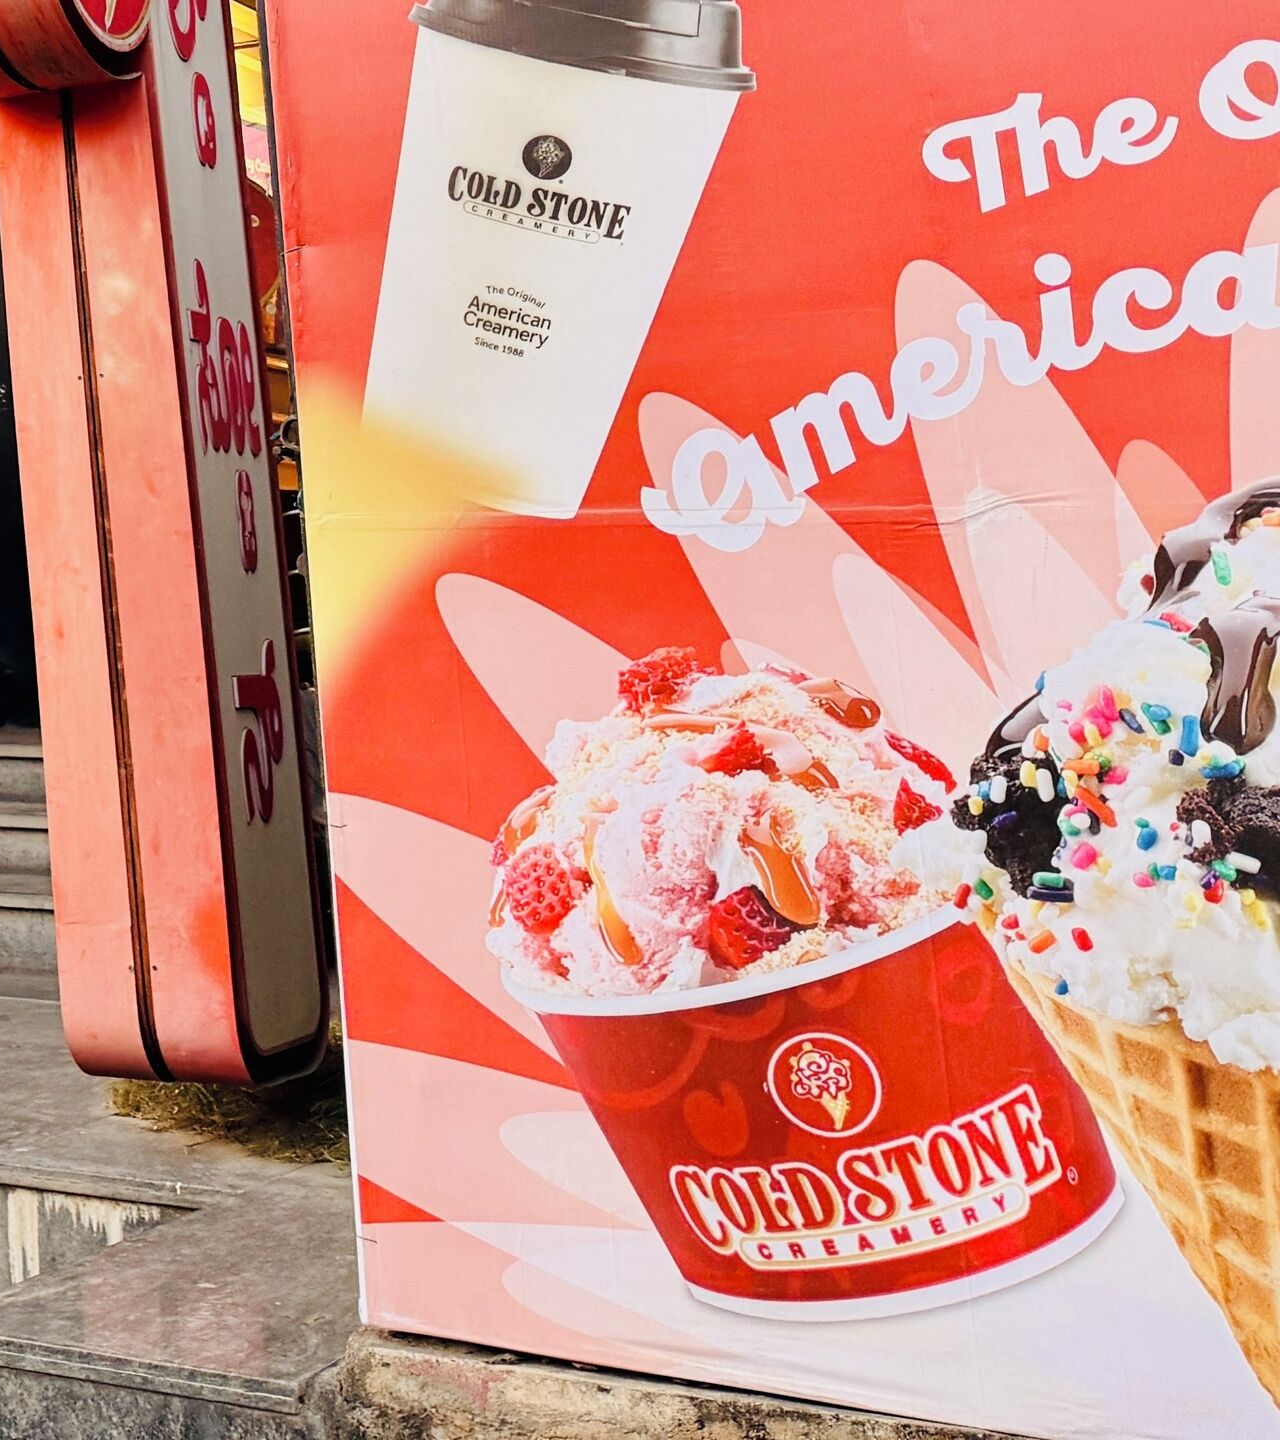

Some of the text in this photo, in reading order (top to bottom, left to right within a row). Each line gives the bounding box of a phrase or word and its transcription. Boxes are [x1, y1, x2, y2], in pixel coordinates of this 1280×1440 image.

[922, 92, 1179, 214] The
[448, 166, 631, 241] COLD STONE
[471, 205, 592, 240] CREAMERY
[467, 295, 552, 330] American
[485, 285, 547, 309] The Original
[463, 310, 550, 349] Creamery
[474, 336, 525, 358] Since 1988
[670, 1086, 1060, 1251] COLD STONE
[757, 1192, 1011, 1261] CREAMERY
